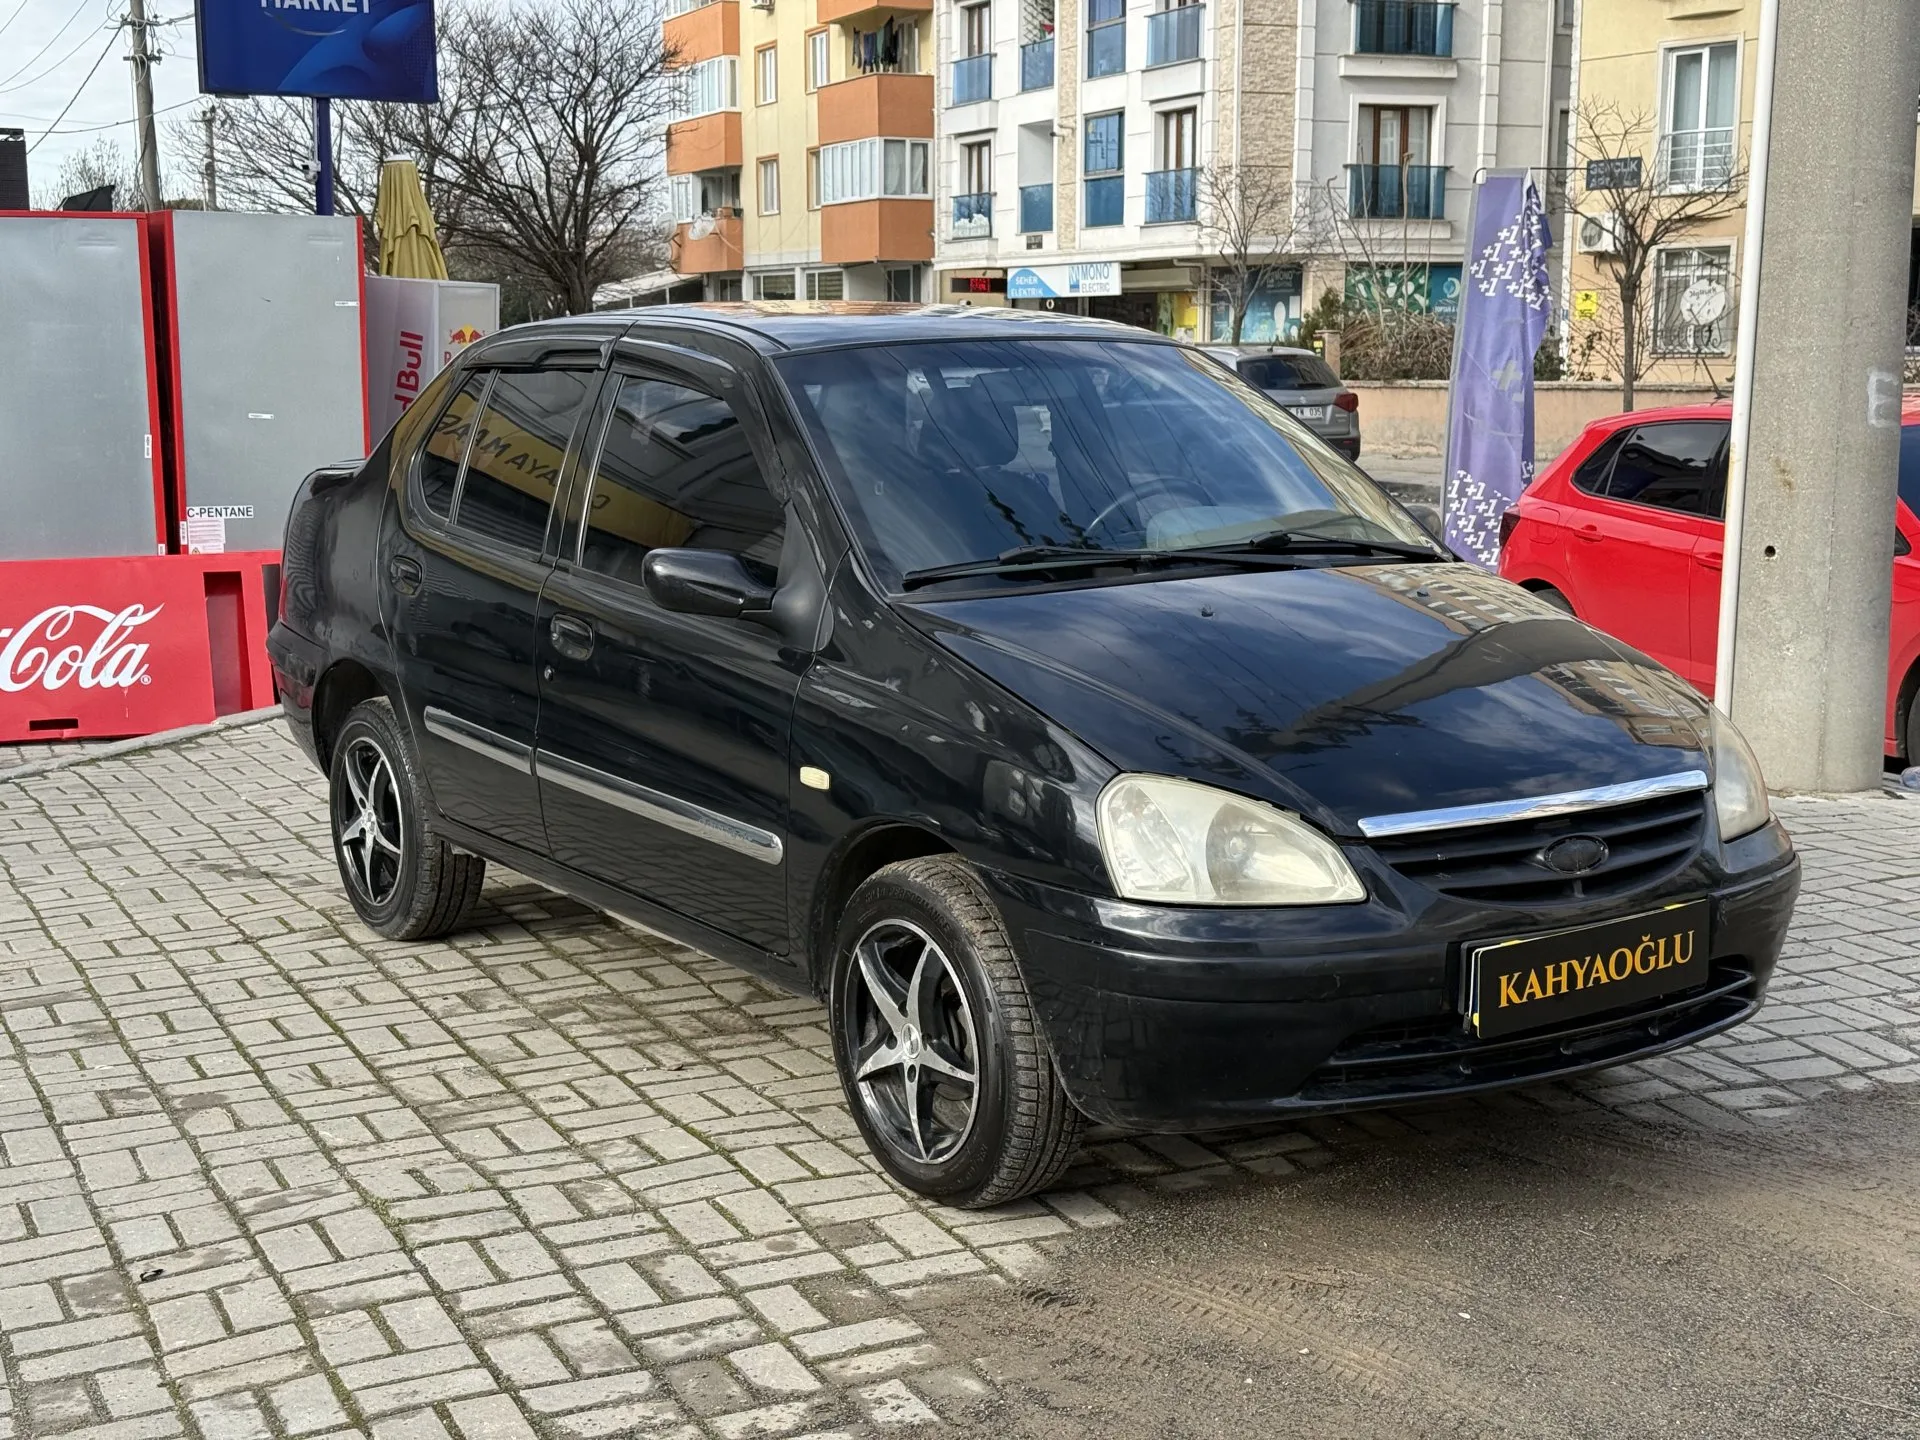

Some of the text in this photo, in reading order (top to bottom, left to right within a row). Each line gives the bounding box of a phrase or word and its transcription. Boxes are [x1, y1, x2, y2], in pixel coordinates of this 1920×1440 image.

[1081, 264, 1109, 280] MONO
[1081, 282, 1110, 293] ELECTRIC
[396, 331, 423, 392] Bull
[187, 506, 253, 518] C-PENTANE
[1499, 929, 1694, 1008] KAHYAOĞLU
